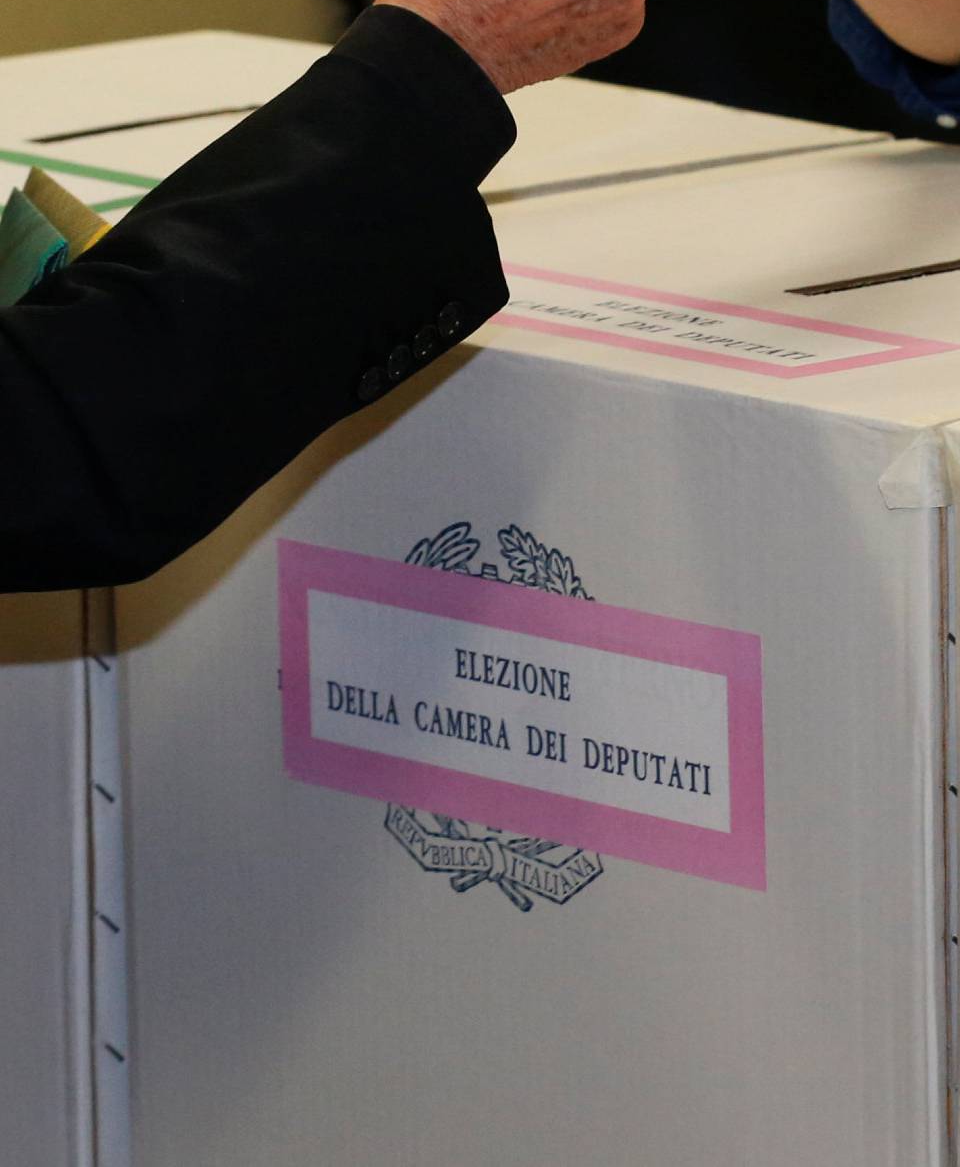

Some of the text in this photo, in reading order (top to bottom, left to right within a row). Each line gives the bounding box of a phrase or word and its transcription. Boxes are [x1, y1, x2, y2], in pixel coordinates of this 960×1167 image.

[594, 300, 724, 327] ELEZIONE
[617, 320, 671, 334] DEI
[674, 331, 816, 361] DEPUTATI
[454, 647, 572, 702] ELEZIONE
[326, 680, 712, 796] DELLA CAMERA DEI DEPUTATI
